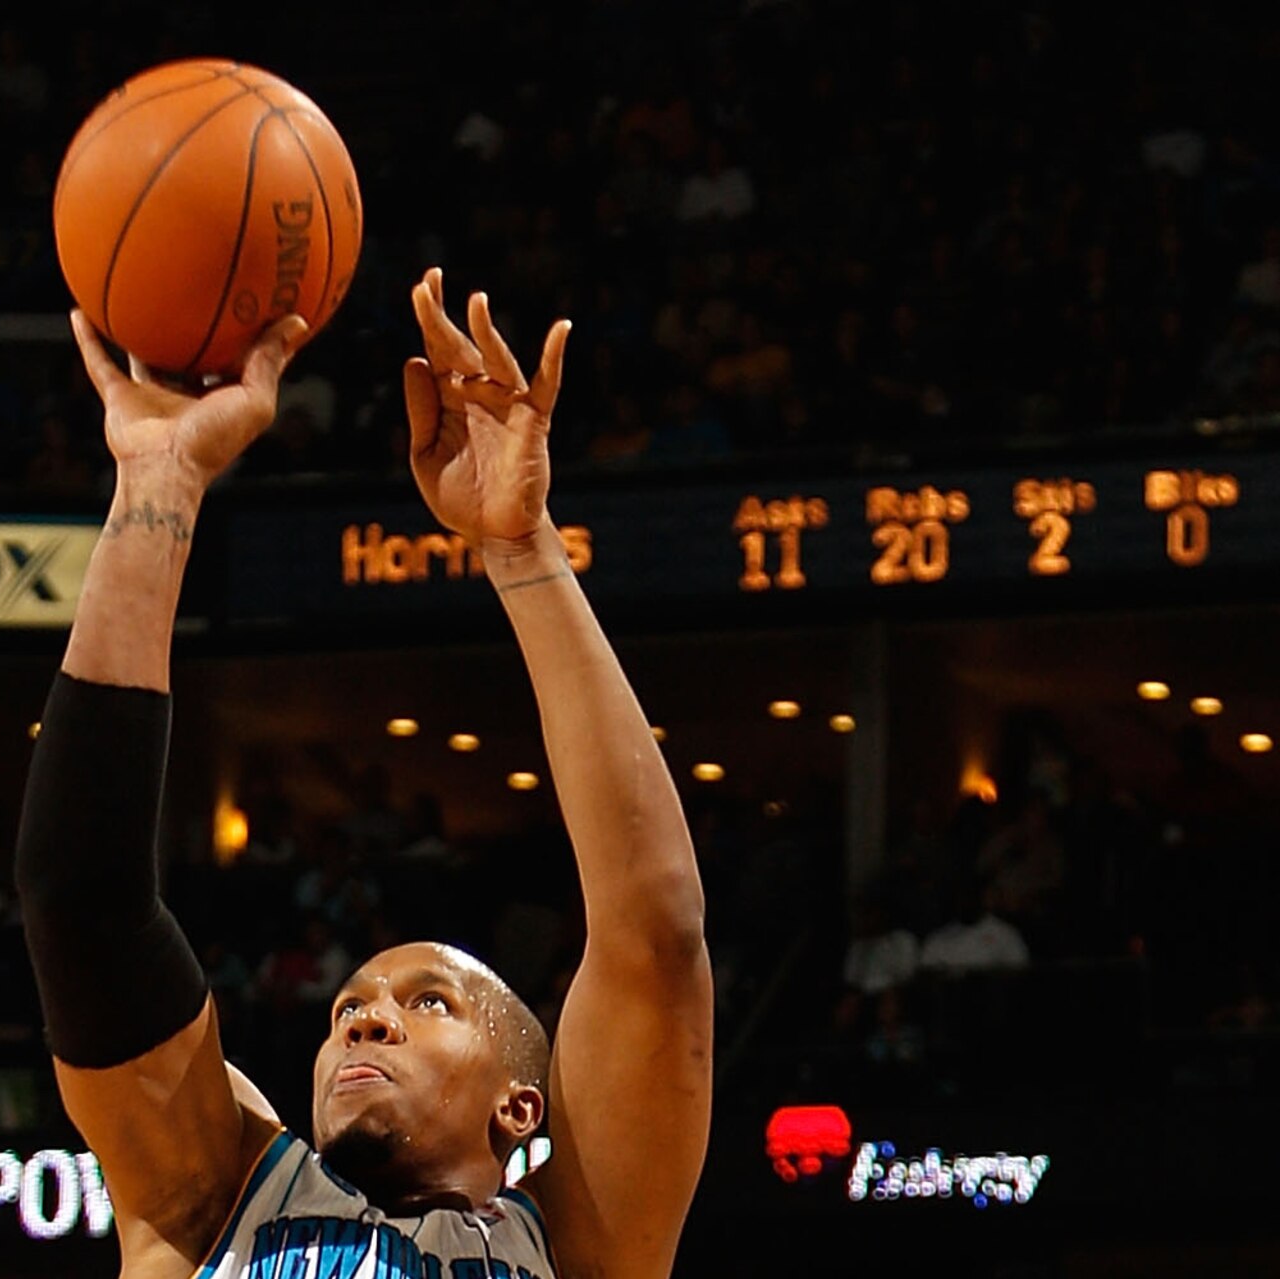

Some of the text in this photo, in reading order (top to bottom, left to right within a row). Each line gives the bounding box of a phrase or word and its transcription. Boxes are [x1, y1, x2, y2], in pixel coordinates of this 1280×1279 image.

[341, 521, 594, 586] Horns
[738, 504, 1210, 593] 11 20 2 0
